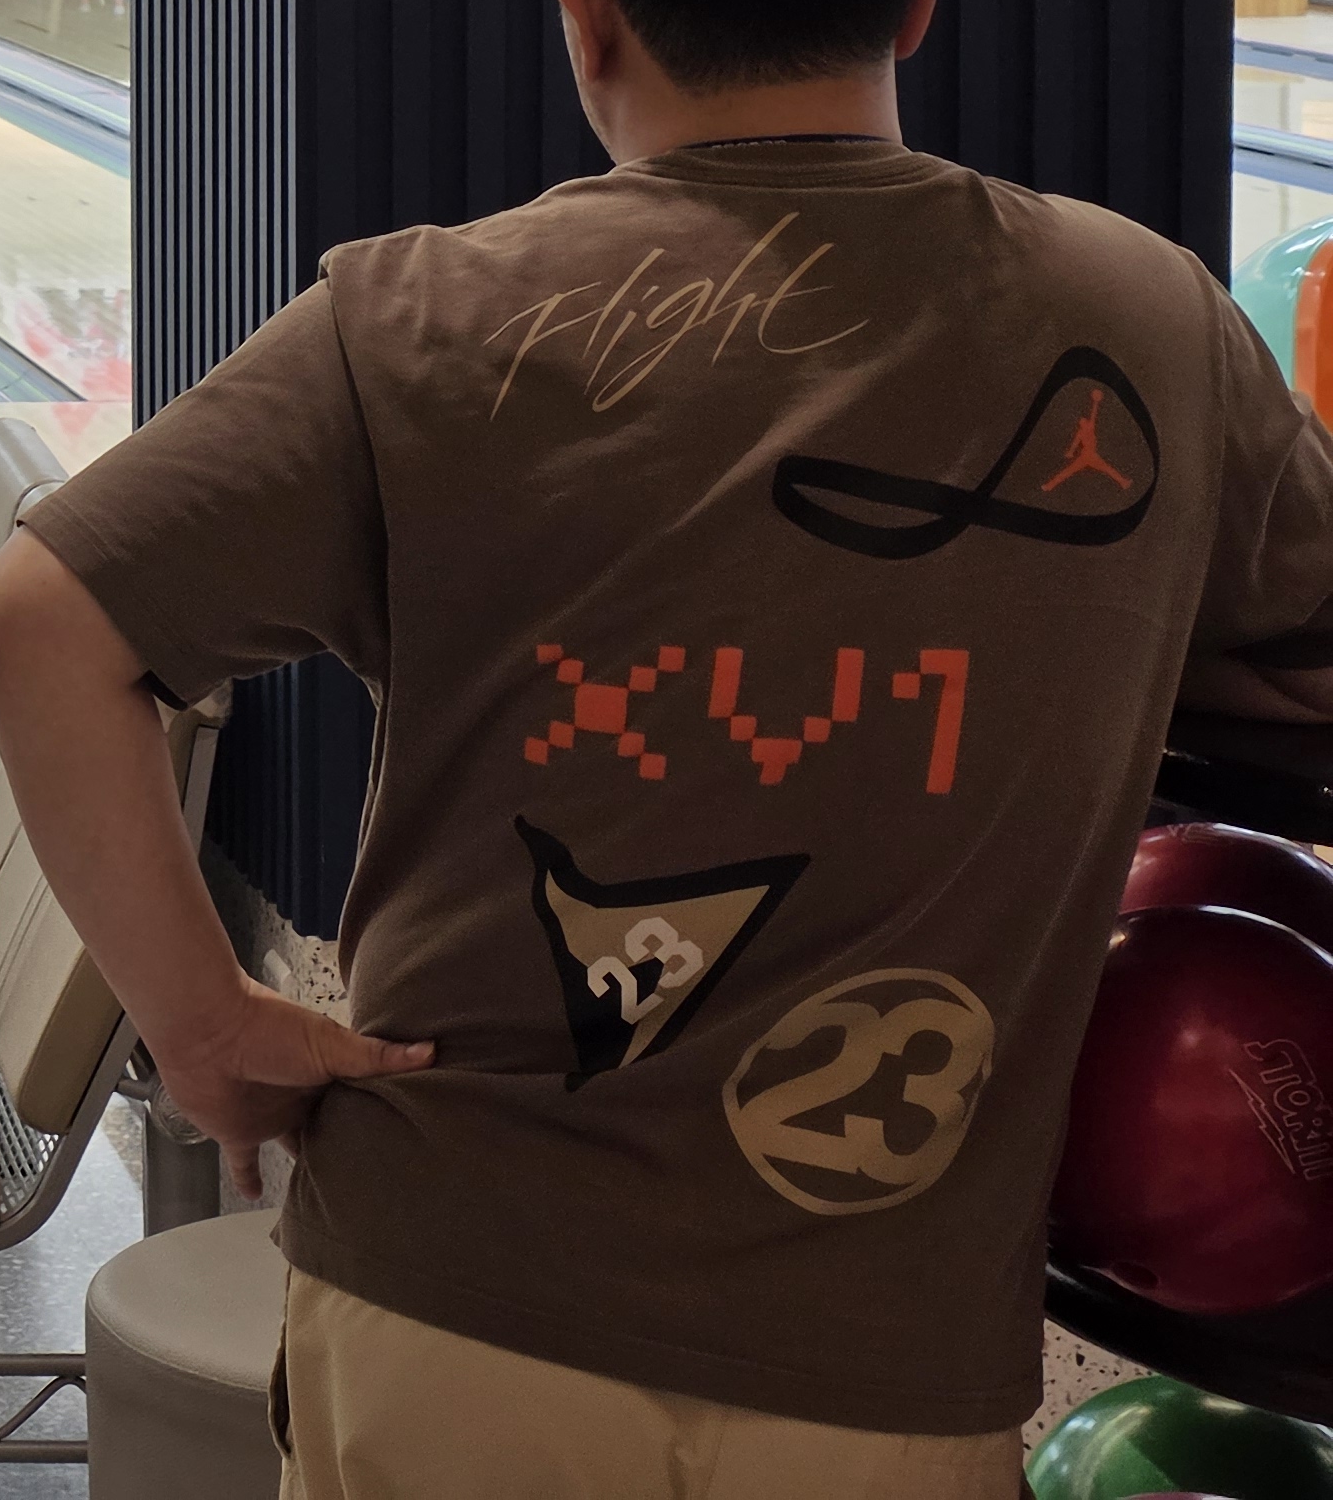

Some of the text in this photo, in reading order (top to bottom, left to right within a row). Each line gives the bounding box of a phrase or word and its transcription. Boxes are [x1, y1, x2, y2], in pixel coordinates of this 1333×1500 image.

[482, 210, 870, 423] Flight
[586, 915, 705, 1026] 23
[735, 998, 985, 1187] 23
